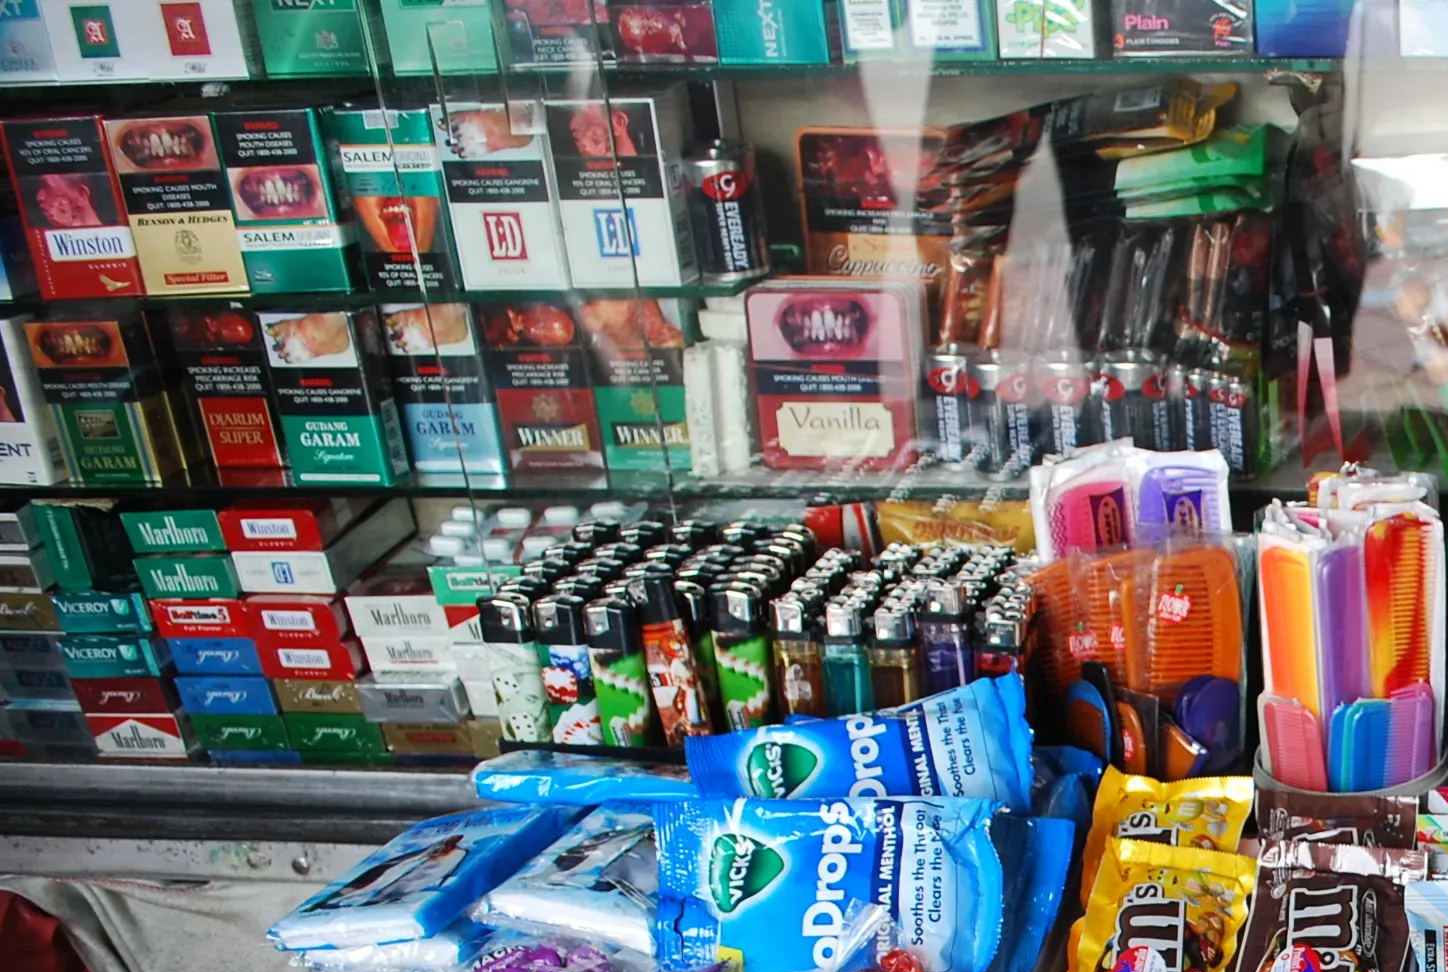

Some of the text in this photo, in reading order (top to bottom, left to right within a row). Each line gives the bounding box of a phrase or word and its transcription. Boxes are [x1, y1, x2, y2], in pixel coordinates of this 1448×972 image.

[1124, 13, 1169, 30] Plain
[137, 216, 175, 227] BENSON
[188, 216, 227, 224] HEDGES
[53, 232, 124, 256] Winston
[244, 232, 294, 243] SALEM
[725, 202, 749, 270] EVEREADY
[209, 412, 266, 427] DJARUM
[305, 421, 348, 432] GUDANG
[789, 405, 881, 433] Vanilla
[220, 431, 264, 445] SUPER
[300, 432, 361, 447] GARAM
[517, 427, 584, 447] WINNER
[80, 457, 137, 469] GARAM
[138, 516, 209, 546] Marlboro
[246, 520, 290, 535] Winston
[55, 601, 110, 614] VICEROY
[371, 603, 431, 626] Marlboro
[110, 725, 166, 750] Marlboro
[877, 805, 896, 883] MENTHOL
[802, 802, 852, 969] oDrops
[911, 808, 929, 946] Soothes the Throat
[1426, 944, 1435, 962] EXTRA
